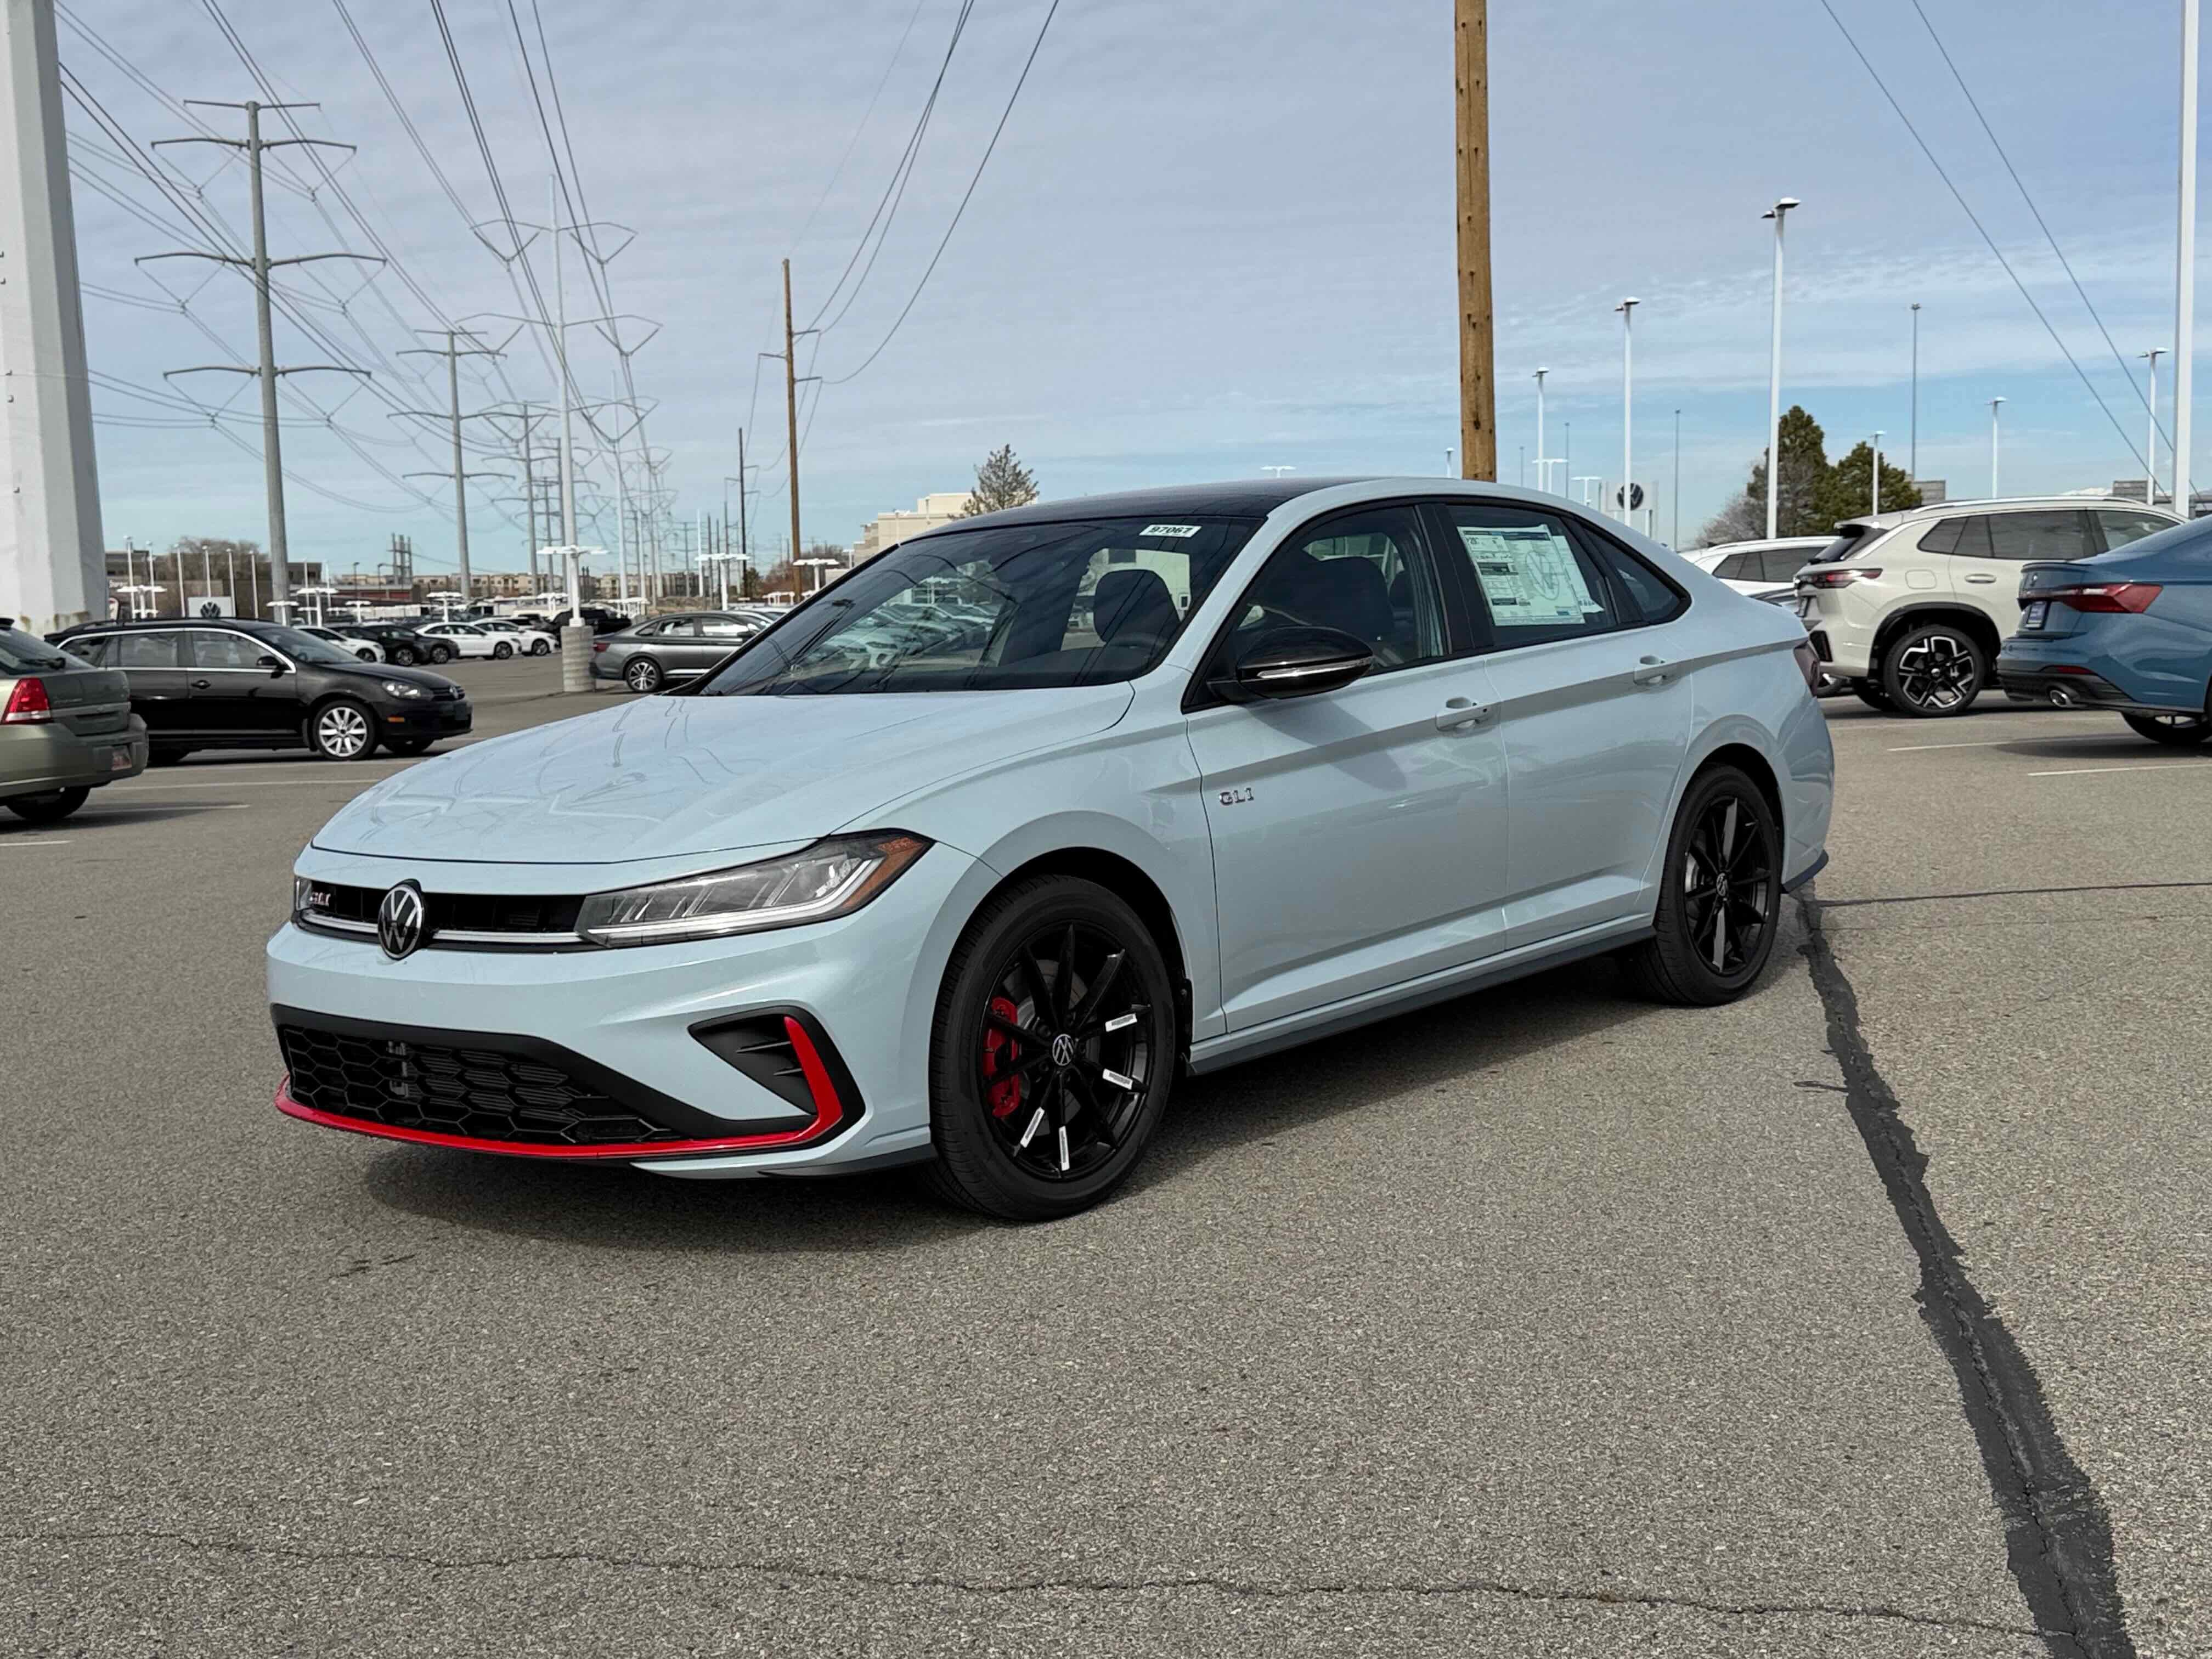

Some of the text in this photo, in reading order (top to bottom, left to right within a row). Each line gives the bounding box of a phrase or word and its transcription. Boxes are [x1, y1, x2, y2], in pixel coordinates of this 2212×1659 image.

[1148, 526, 1194, 534] 97067
[1220, 787, 1255, 806] GLI
[309, 891, 331, 907] GLI
